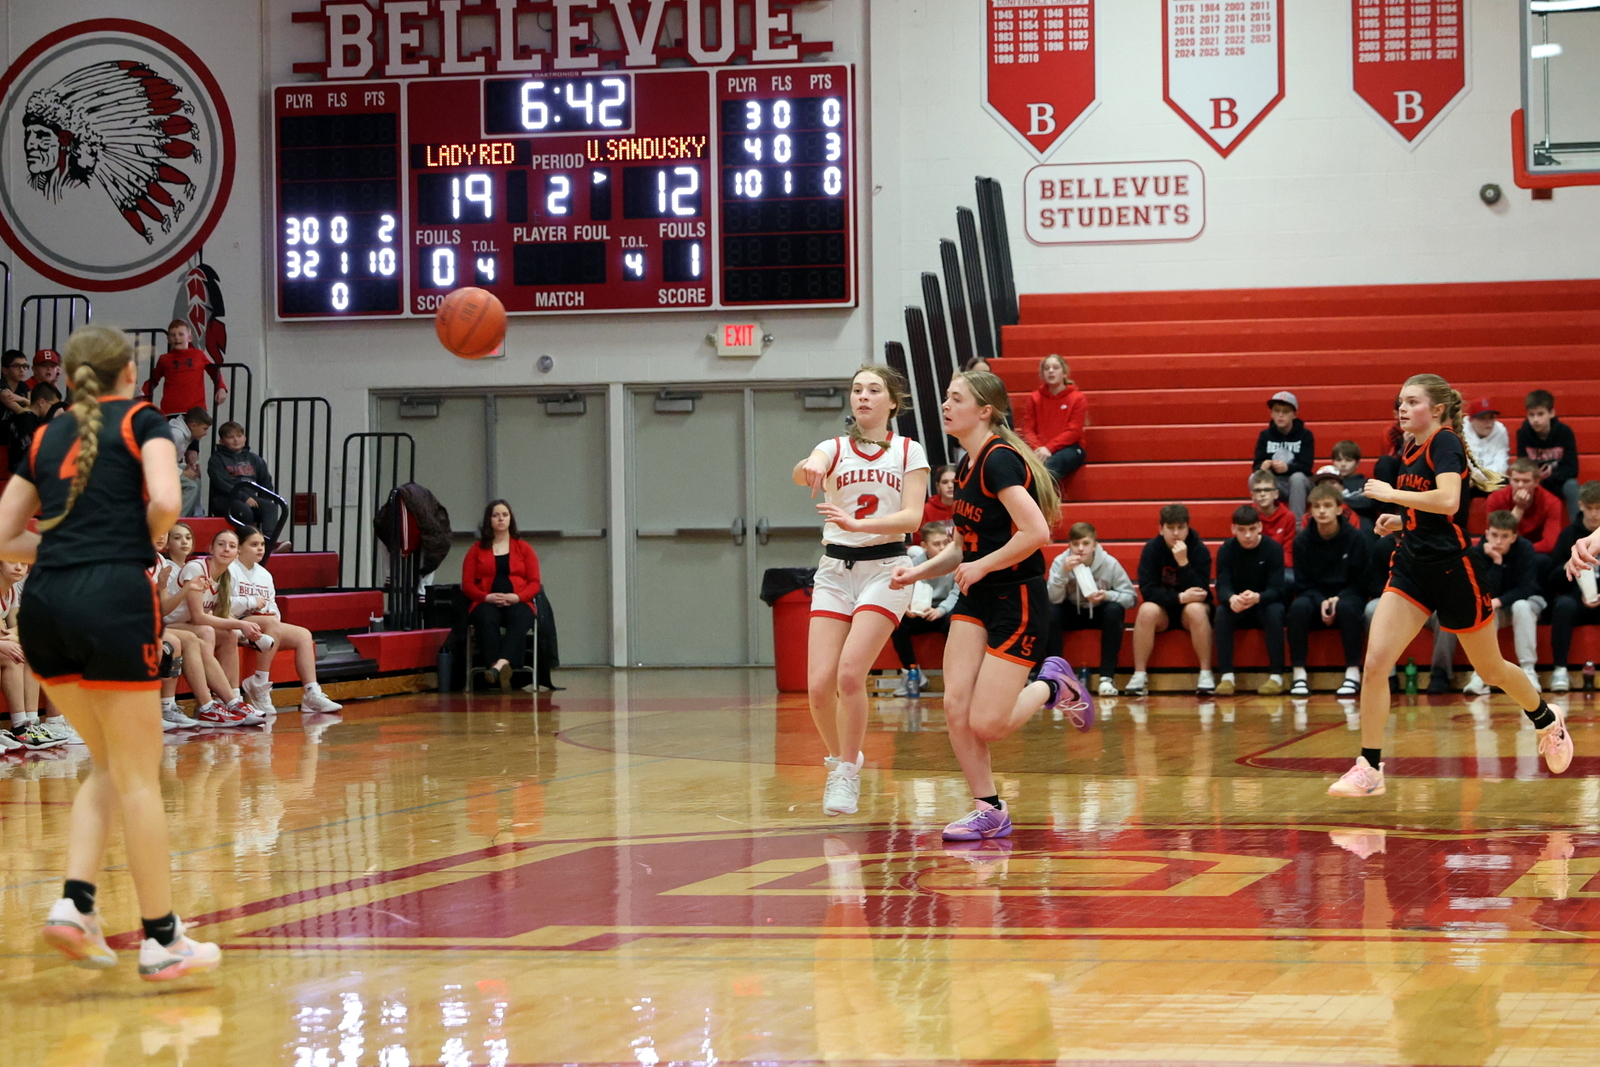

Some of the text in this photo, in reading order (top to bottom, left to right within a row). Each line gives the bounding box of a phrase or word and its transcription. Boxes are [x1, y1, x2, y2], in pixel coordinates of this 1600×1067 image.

[1019, 9, 1038, 19] 1947
[1250, 1, 1270, 10] 2011
[1175, 15, 1195, 25] 2012
[1200, 14, 1220, 24] 2013
[1225, 13, 1246, 23] 2014
[1200, 26, 1220, 35] 2017
[325, 0, 799, 80] BELLEVUE
[1175, 38, 1195, 47] 2020
[1200, 37, 1219, 46] 2021
[1225, 35, 1245, 45] 2022
[1018, 53, 1039, 63] 2010
[1175, 49, 1195, 58] 2024
[727, 74, 832, 93] PLYR FLS PTS
[285, 91, 385, 109] PLYR FLS PTS
[521, 78, 625, 130] 6:42
[1393, 90, 1425, 124] B
[746, 98, 841, 130] 3 0 0
[1026, 102, 1057, 136] B
[1209, 97, 1239, 130] B
[744, 132, 841, 163] 4 0 3
[532, 153, 584, 169] PERIOD
[658, 166, 699, 216] 12
[735, 166, 841, 198] 10 1 0
[1040, 175, 1189, 200] BELLEVUE
[452, 173, 492, 219] 19
[547, 176, 570, 214] 2
[1040, 204, 1190, 229] STUDENTS
[286, 214, 395, 245] 30 0 2
[416, 230, 461, 245] FOULS
[514, 225, 611, 242] PLAYER FOUL
[620, 236, 648, 248] T.O.L.
[659, 222, 706, 238] FOULS
[472, 240, 500, 252] T.O.L.
[286, 248, 396, 278] 32 1 10
[432, 248, 455, 286] 0
[476, 257, 495, 281] 4
[624, 252, 643, 277] 4
[691, 243, 700, 277] 1
[331, 282, 349, 310] 0
[417, 294, 446, 311] SCO
[535, 291, 585, 307] MATCH
[658, 288, 706, 303] SCORE
[725, 324, 755, 346] EXIT
[836, 468, 902, 494] BELLEVUE
[854, 493, 880, 521] 2
